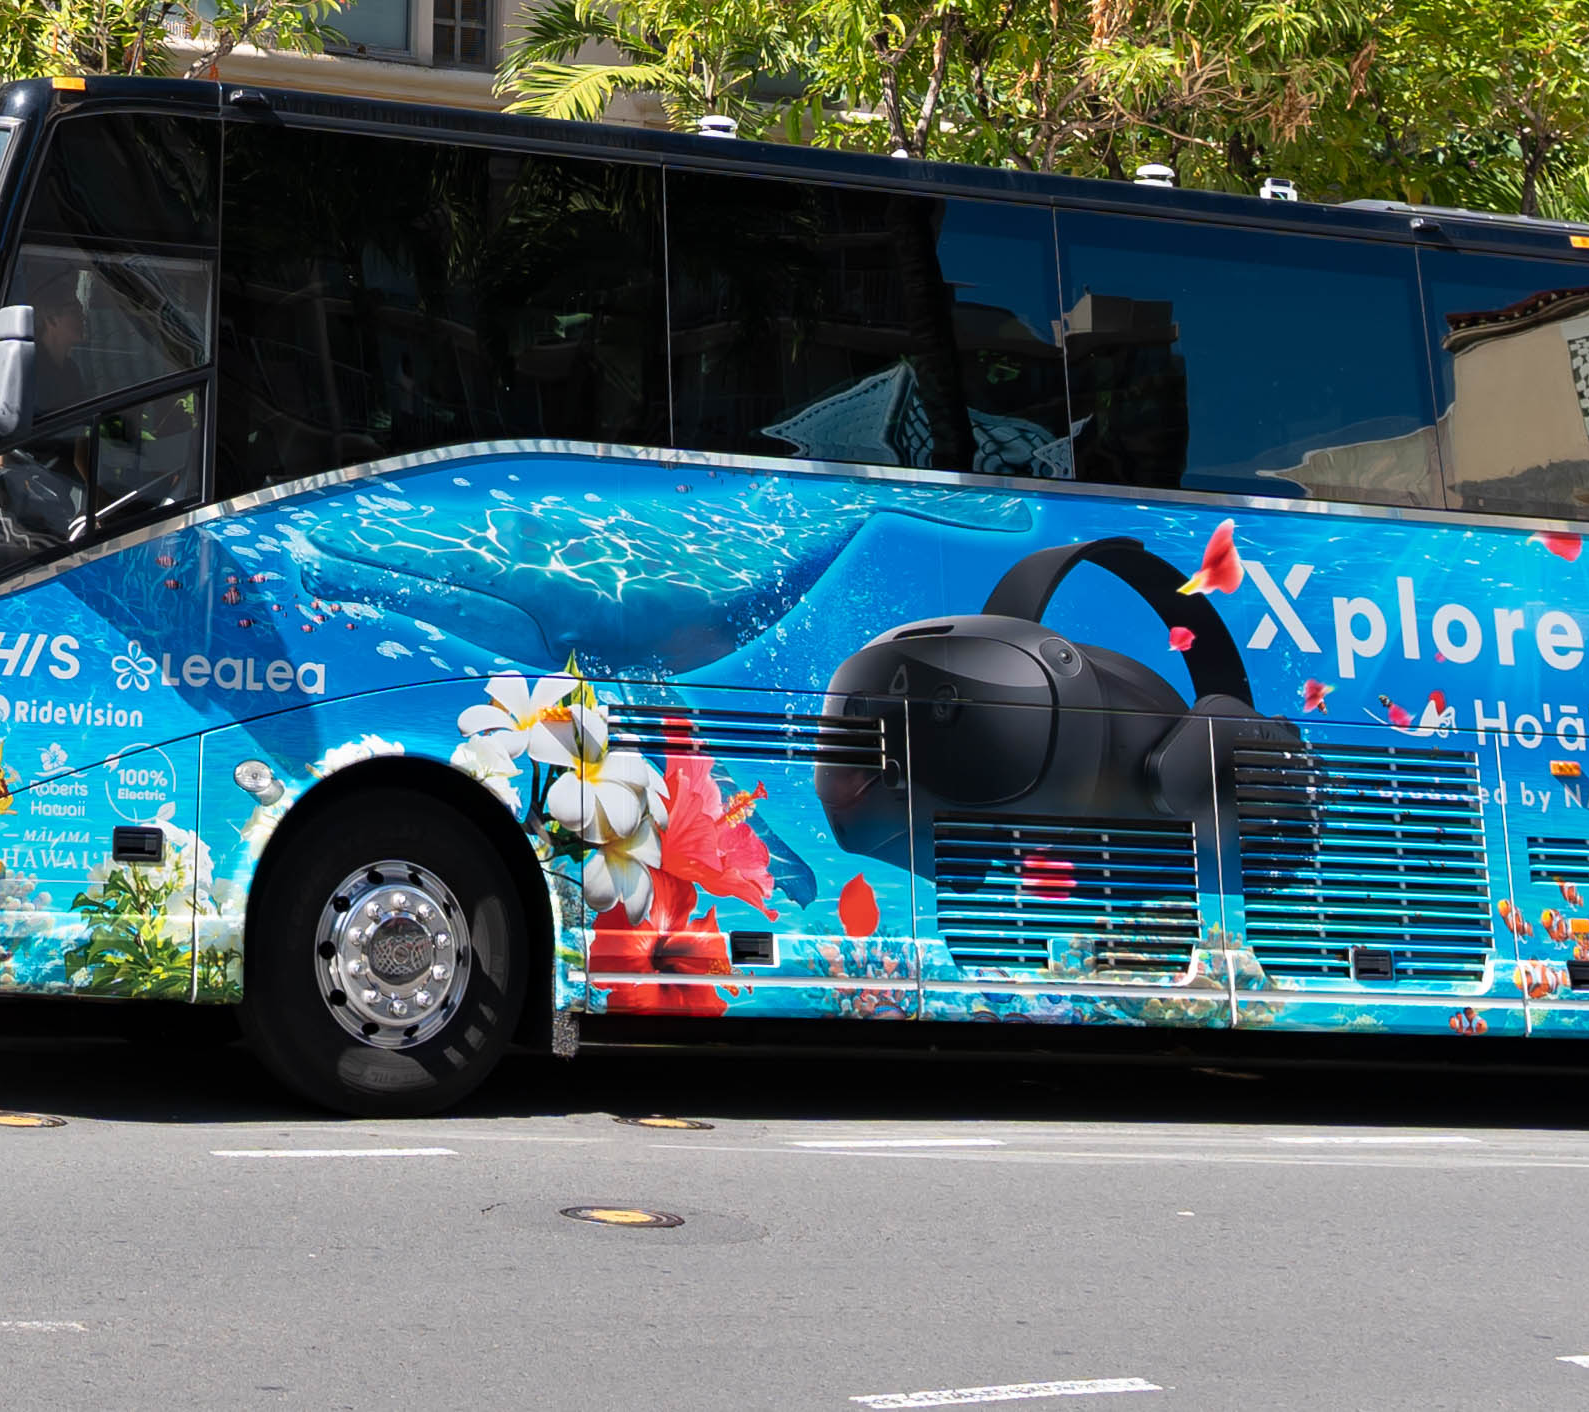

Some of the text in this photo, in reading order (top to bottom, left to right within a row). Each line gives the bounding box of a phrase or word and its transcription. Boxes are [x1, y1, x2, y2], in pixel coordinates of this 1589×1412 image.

[14, 699, 144, 728] RideVision
[116, 768, 169, 788] 100%
[29, 779, 89, 798] Roberts
[117, 788, 166, 802] Electric
[1521, 782, 1552, 814] by
[30, 800, 87, 817] Hawaii
